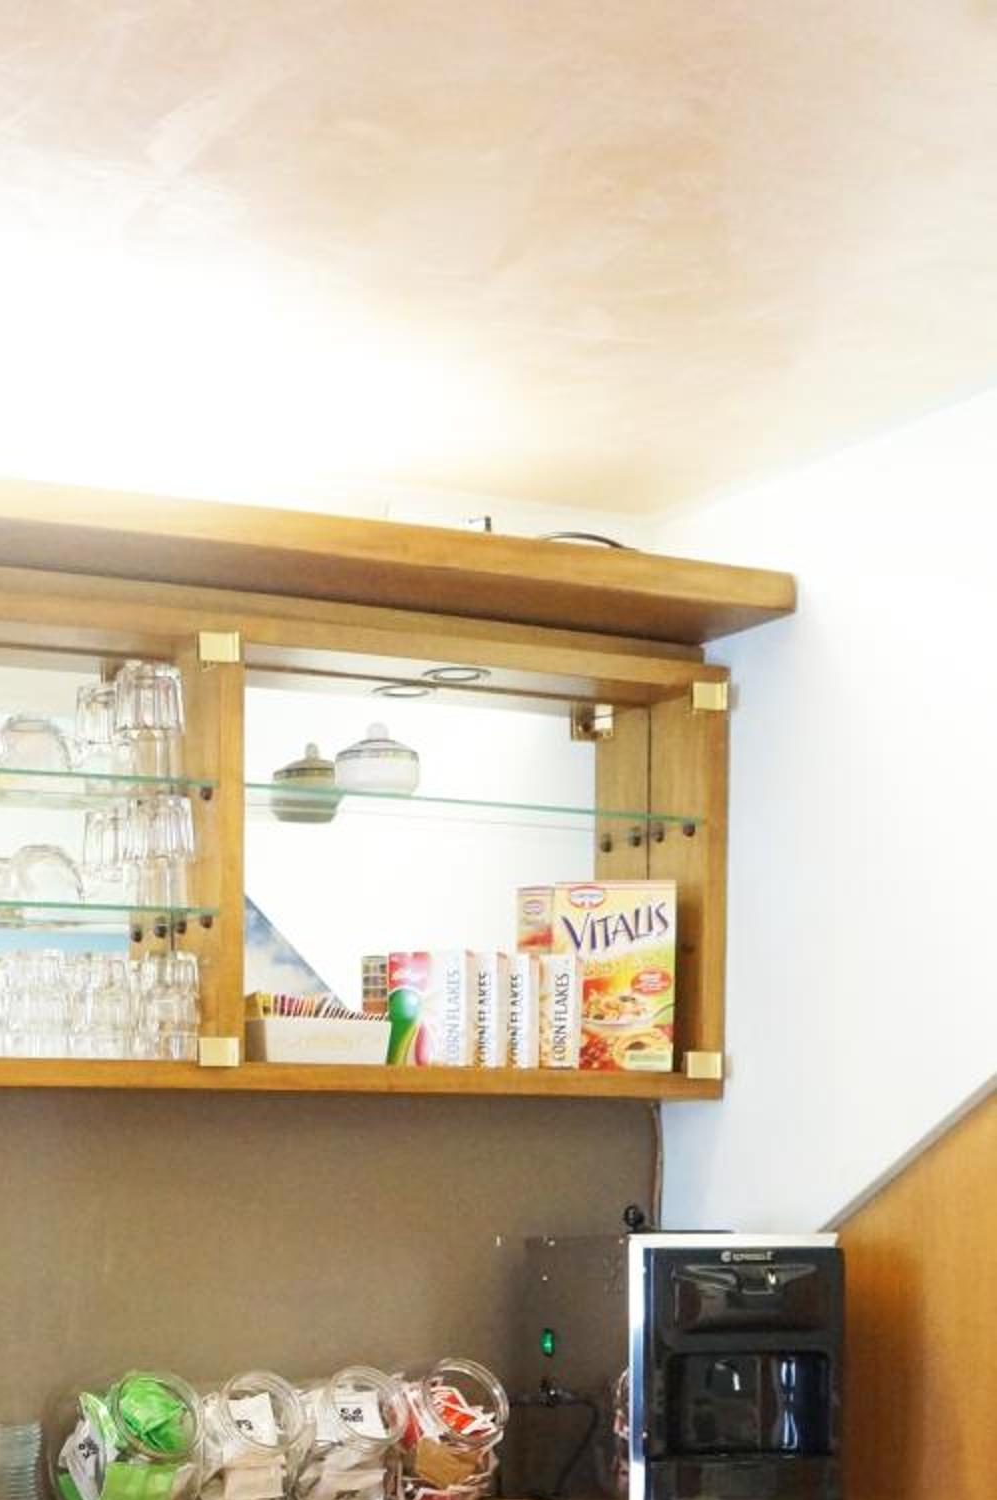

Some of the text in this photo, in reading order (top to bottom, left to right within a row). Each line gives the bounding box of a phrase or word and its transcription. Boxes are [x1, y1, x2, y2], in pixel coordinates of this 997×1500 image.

[561, 902, 669, 950] VITALIS
[445, 969, 460, 1061] CORN FLAKES
[478, 971, 491, 1022] FLAKES
[510, 973, 523, 1022] FLAKES
[553, 972, 570, 1061] CORN FLAKES
